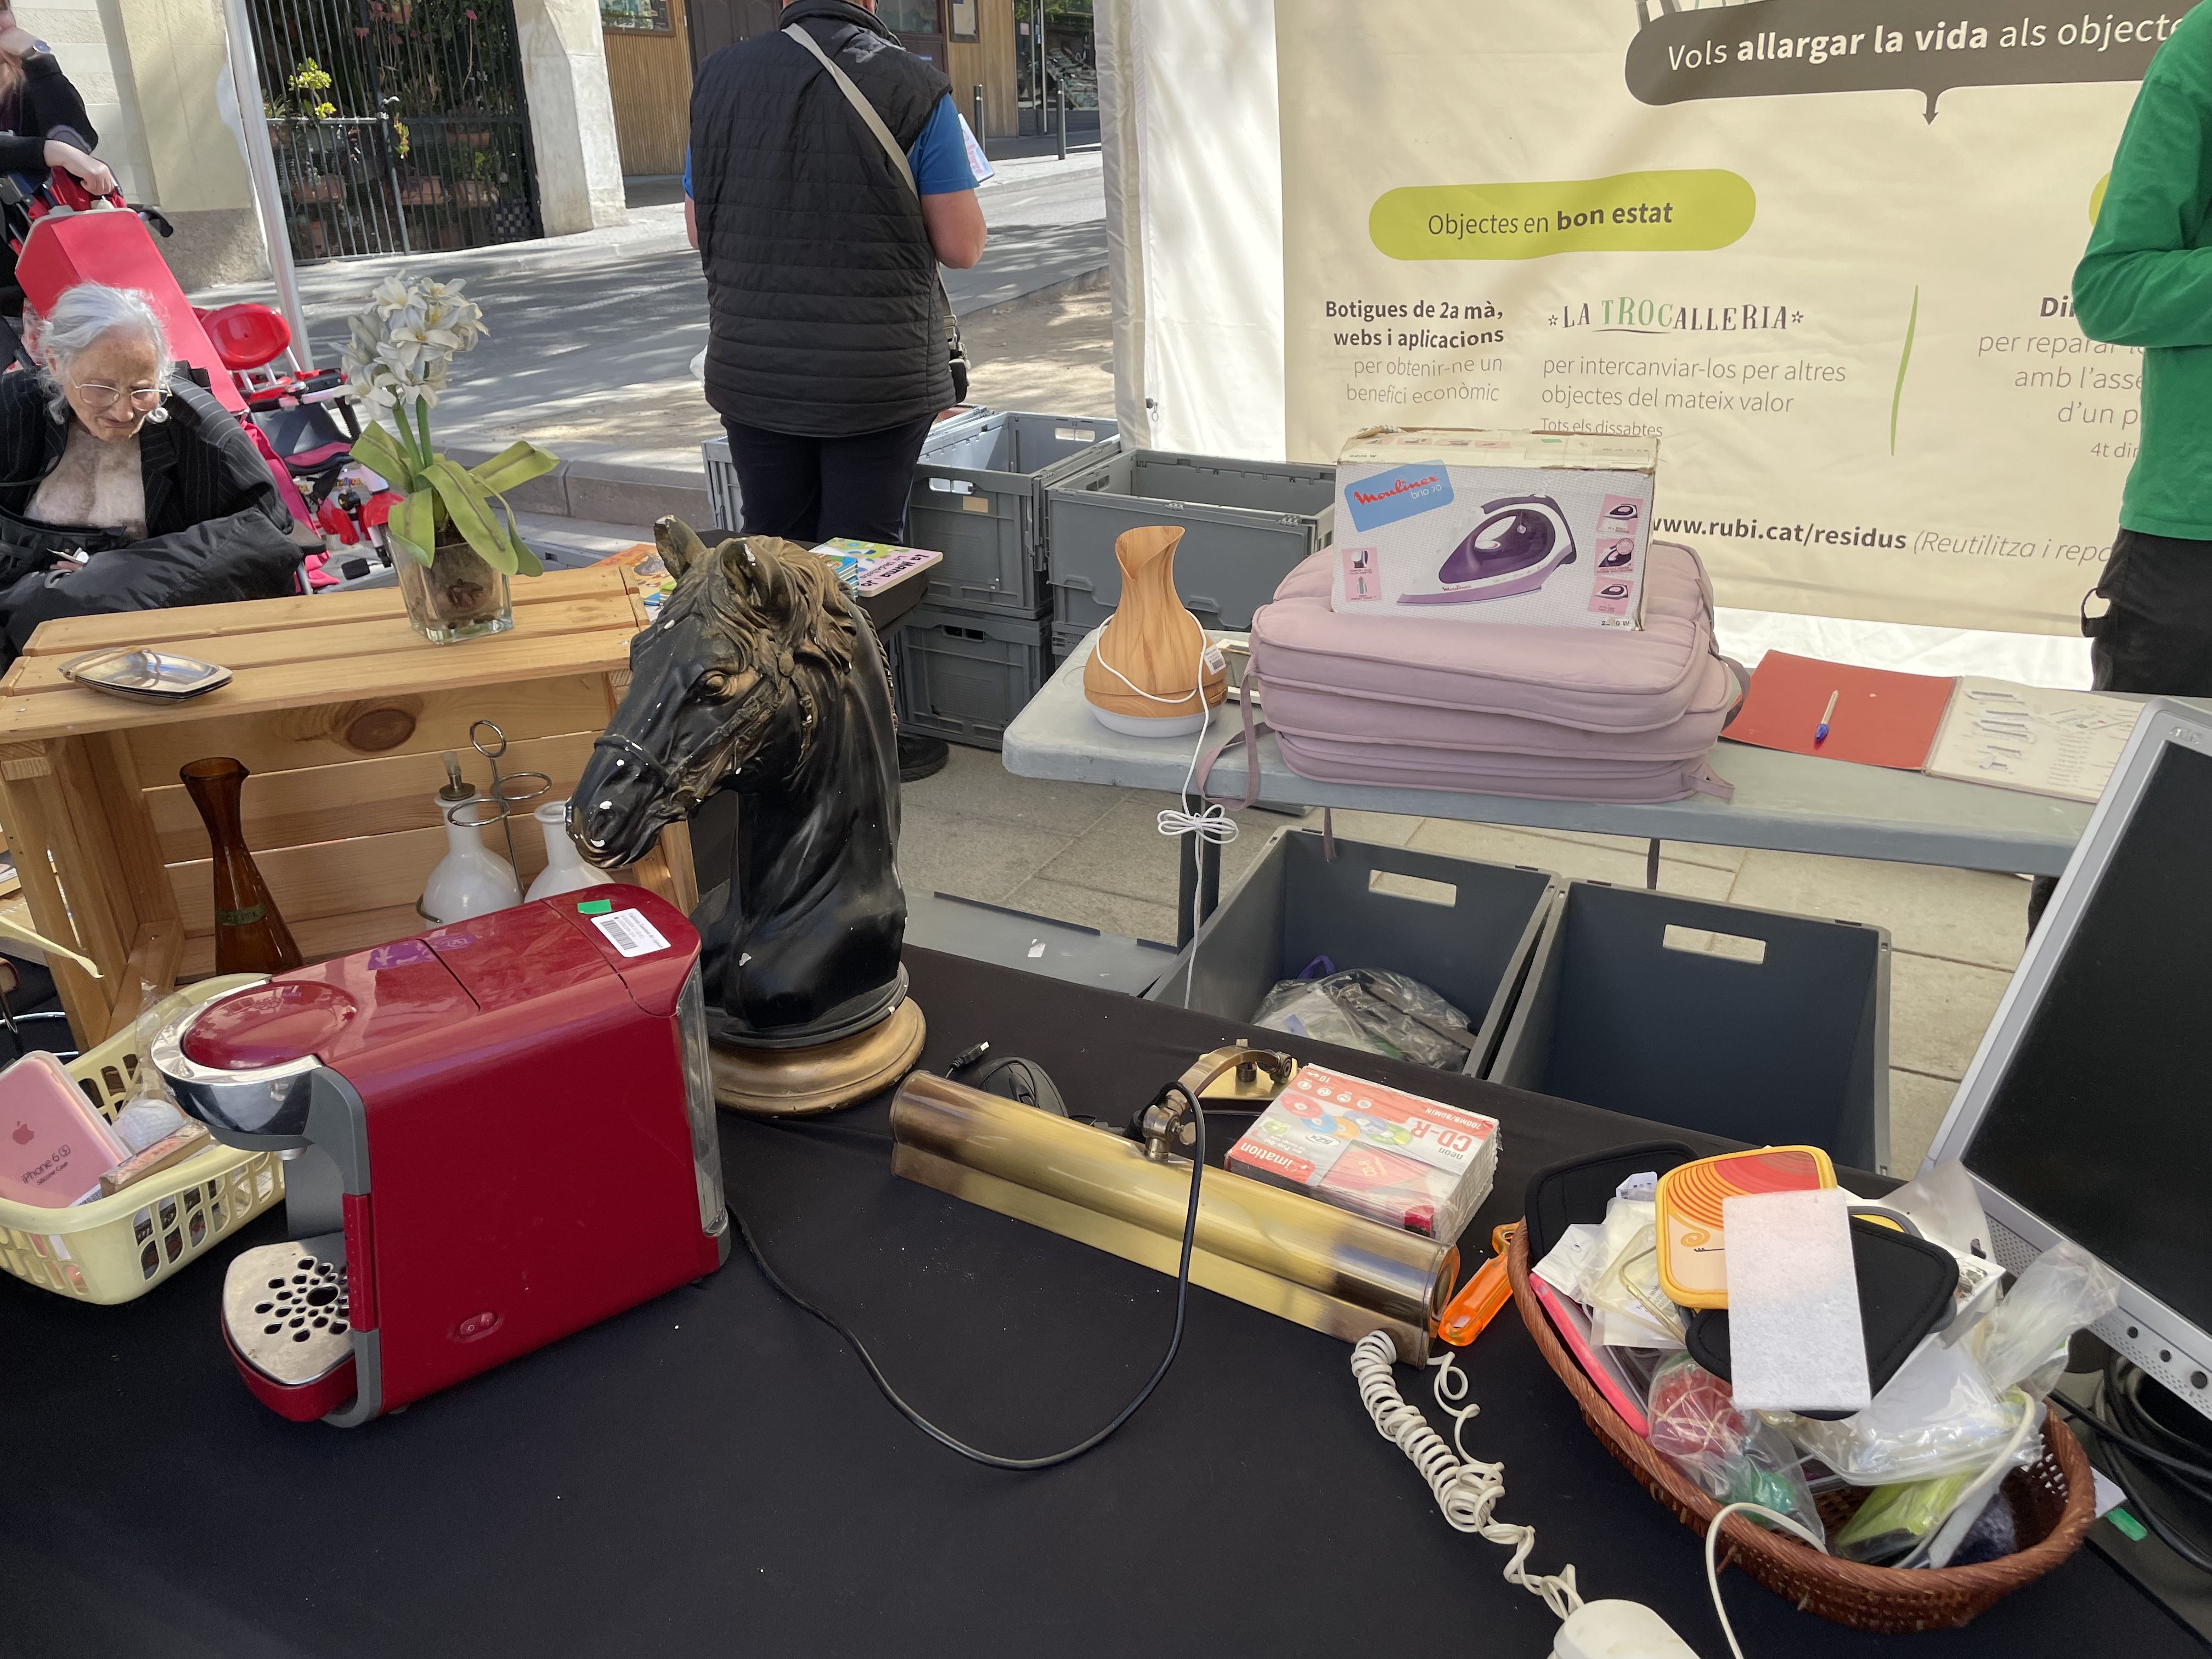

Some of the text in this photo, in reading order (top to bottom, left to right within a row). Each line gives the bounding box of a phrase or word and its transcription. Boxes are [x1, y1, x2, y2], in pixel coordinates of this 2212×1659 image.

[1669, 41, 1727, 70] Vols
[1737, 32, 1865, 64] allargar
[1875, 25, 1903, 53] la
[1915, 21, 1988, 50] vida
[2000, 18, 2046, 47] als
[1429, 202, 1673, 240] Objectes en bon estat
[1326, 300, 1503, 322] Botigues de 2a mà,
[1563, 303, 1590, 328] LA
[1334, 328, 1504, 351] webs i aplicacions
[1978, 336, 2021, 357] per
[1355, 357, 1502, 376] per obtenir-ne un
[1544, 357, 1846, 382] per intercanviar-los per altres
[2015, 366, 2071, 388] amb
[1347, 382, 1499, 404] benefici econòmic
[1542, 385, 1794, 412] objectes del mateix valor
[2058, 401, 2113, 424] d'un
[1540, 418, 1662, 437] Tots els dissabtes
[2090, 443, 2109, 458] 4t
[1410, 484, 1442, 500] brio 70
[1914, 530, 2036, 557] (Reutilitza
[2042, 539, 2052, 558] i
[1410, 1121, 1472, 1152] CD-R
[1240, 1142, 1293, 1169] imation
[1438, 1148, 1464, 1160] neon
[21, 1160, 53, 1184] iPhone
[52, 1153, 59, 1161] 6
